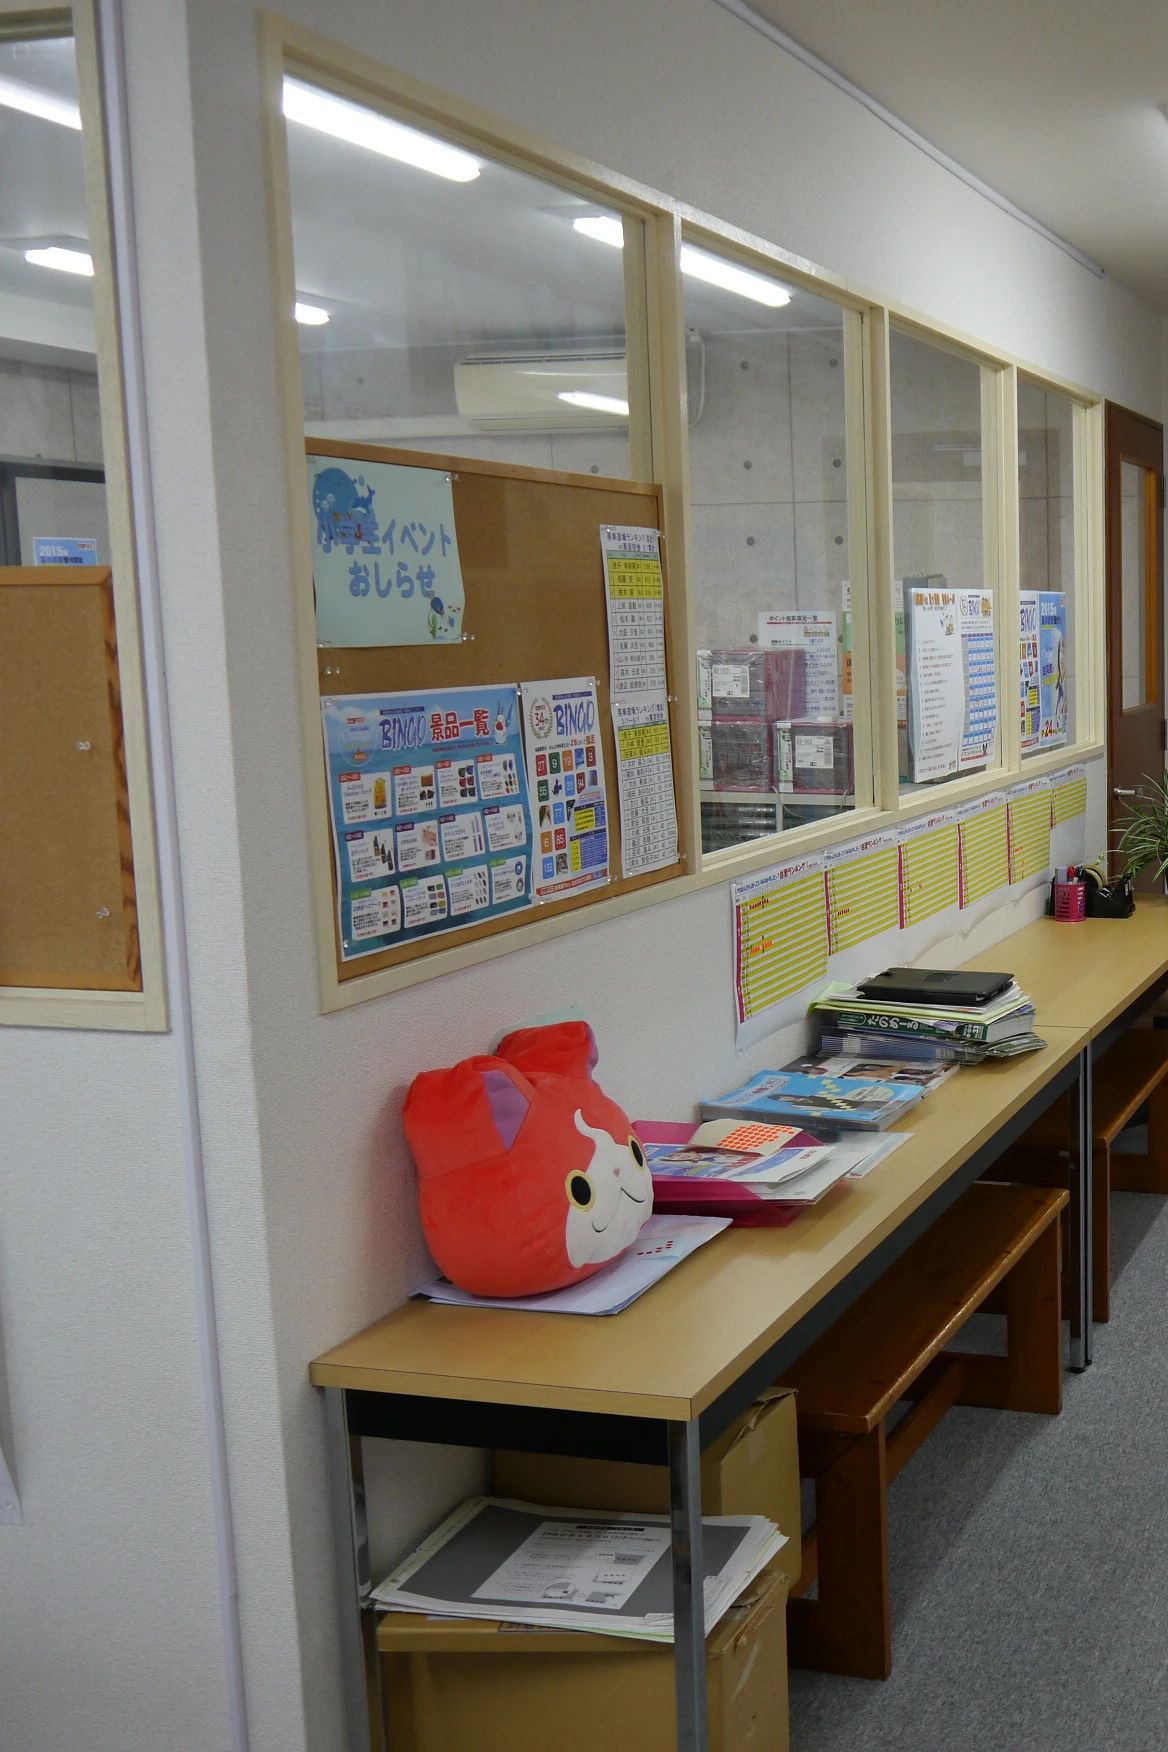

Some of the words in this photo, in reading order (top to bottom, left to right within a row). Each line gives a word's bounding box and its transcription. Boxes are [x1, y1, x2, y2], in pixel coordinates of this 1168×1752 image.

[349, 560, 436, 598] おしらせ
[380, 715, 427, 750] BINGO
[430, 709, 490, 742] 景品一覧
[553, 701, 594, 736] BINGO
[538, 761, 545, 771] 27
[552, 759, 557, 768] 9
[588, 753, 593, 761] 3
